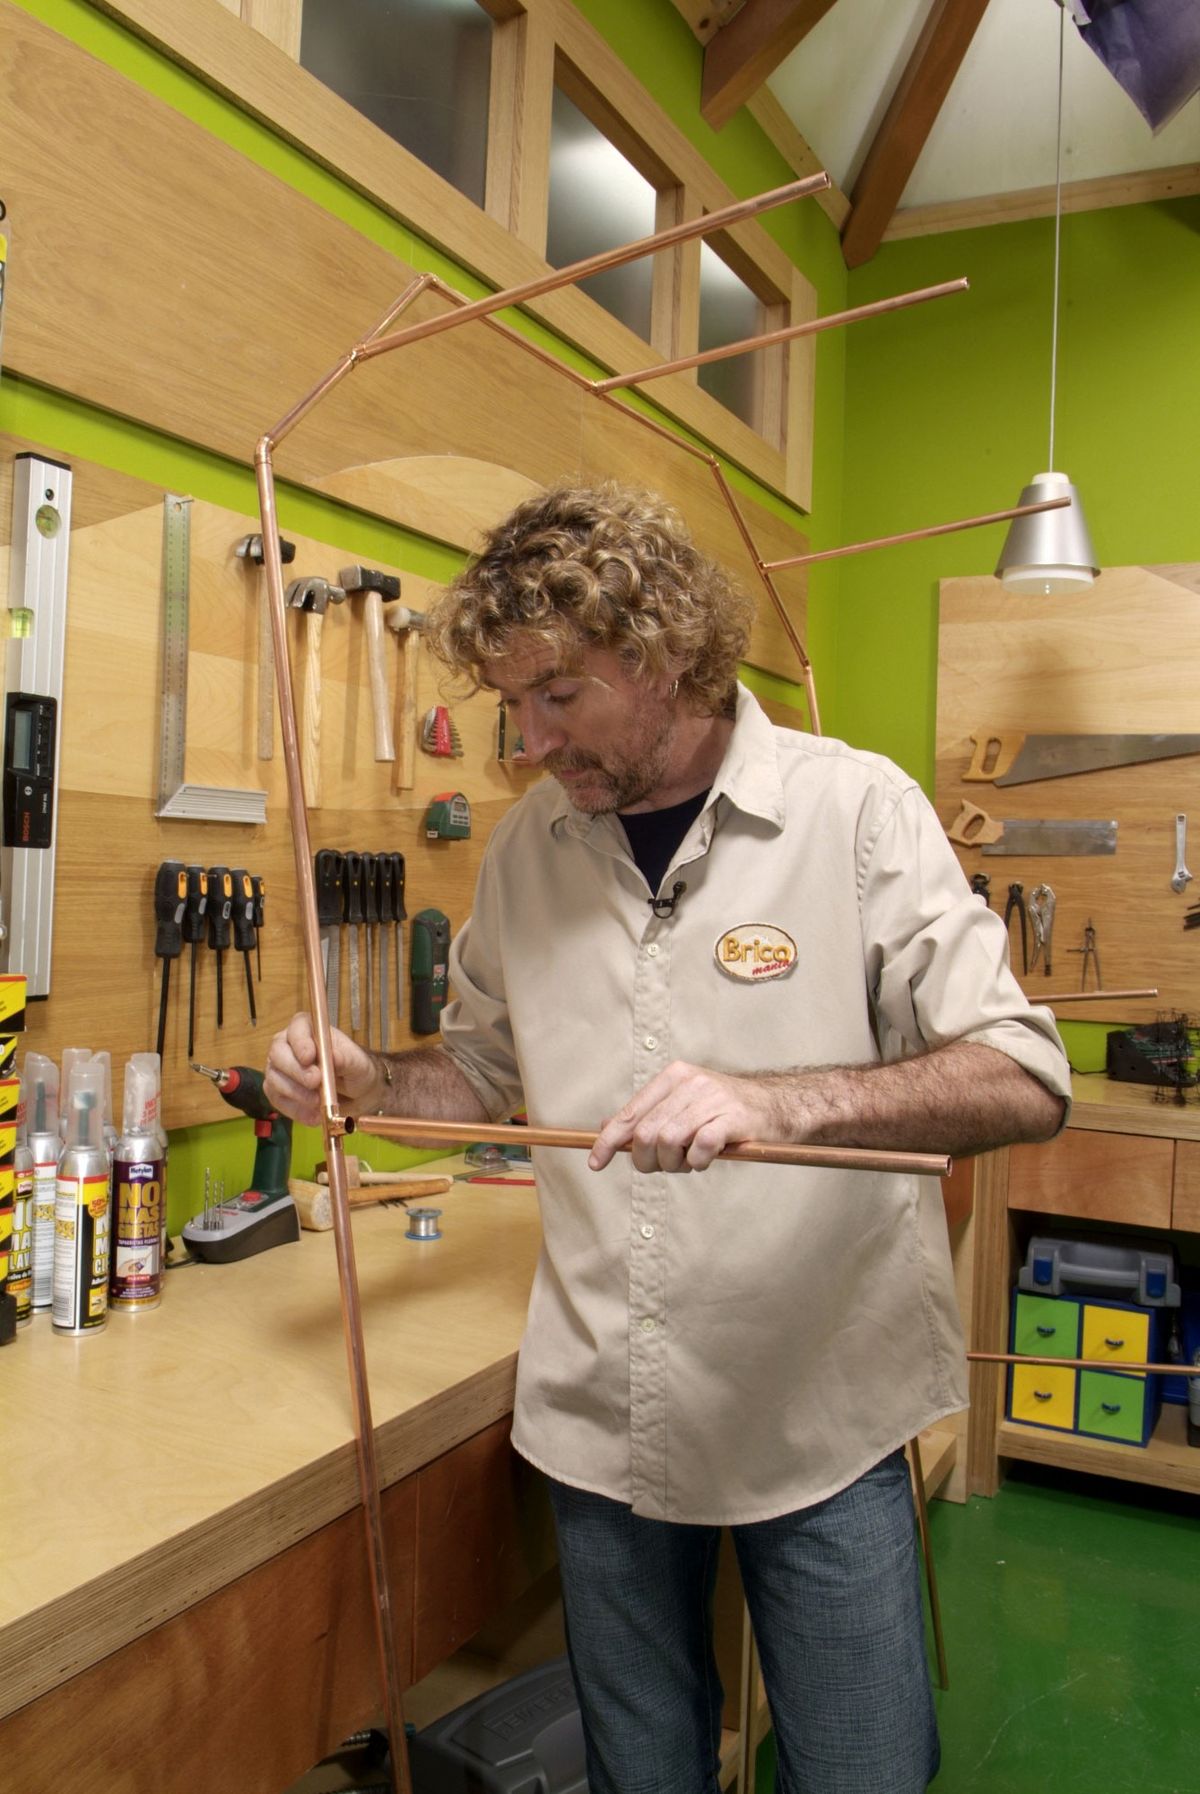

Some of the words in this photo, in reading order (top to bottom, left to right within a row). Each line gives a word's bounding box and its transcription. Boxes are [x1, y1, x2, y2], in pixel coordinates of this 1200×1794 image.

[22, 811, 31, 842] BOSCH
[722, 937, 791, 963] Brico
[119, 1181, 160, 1208] NO
